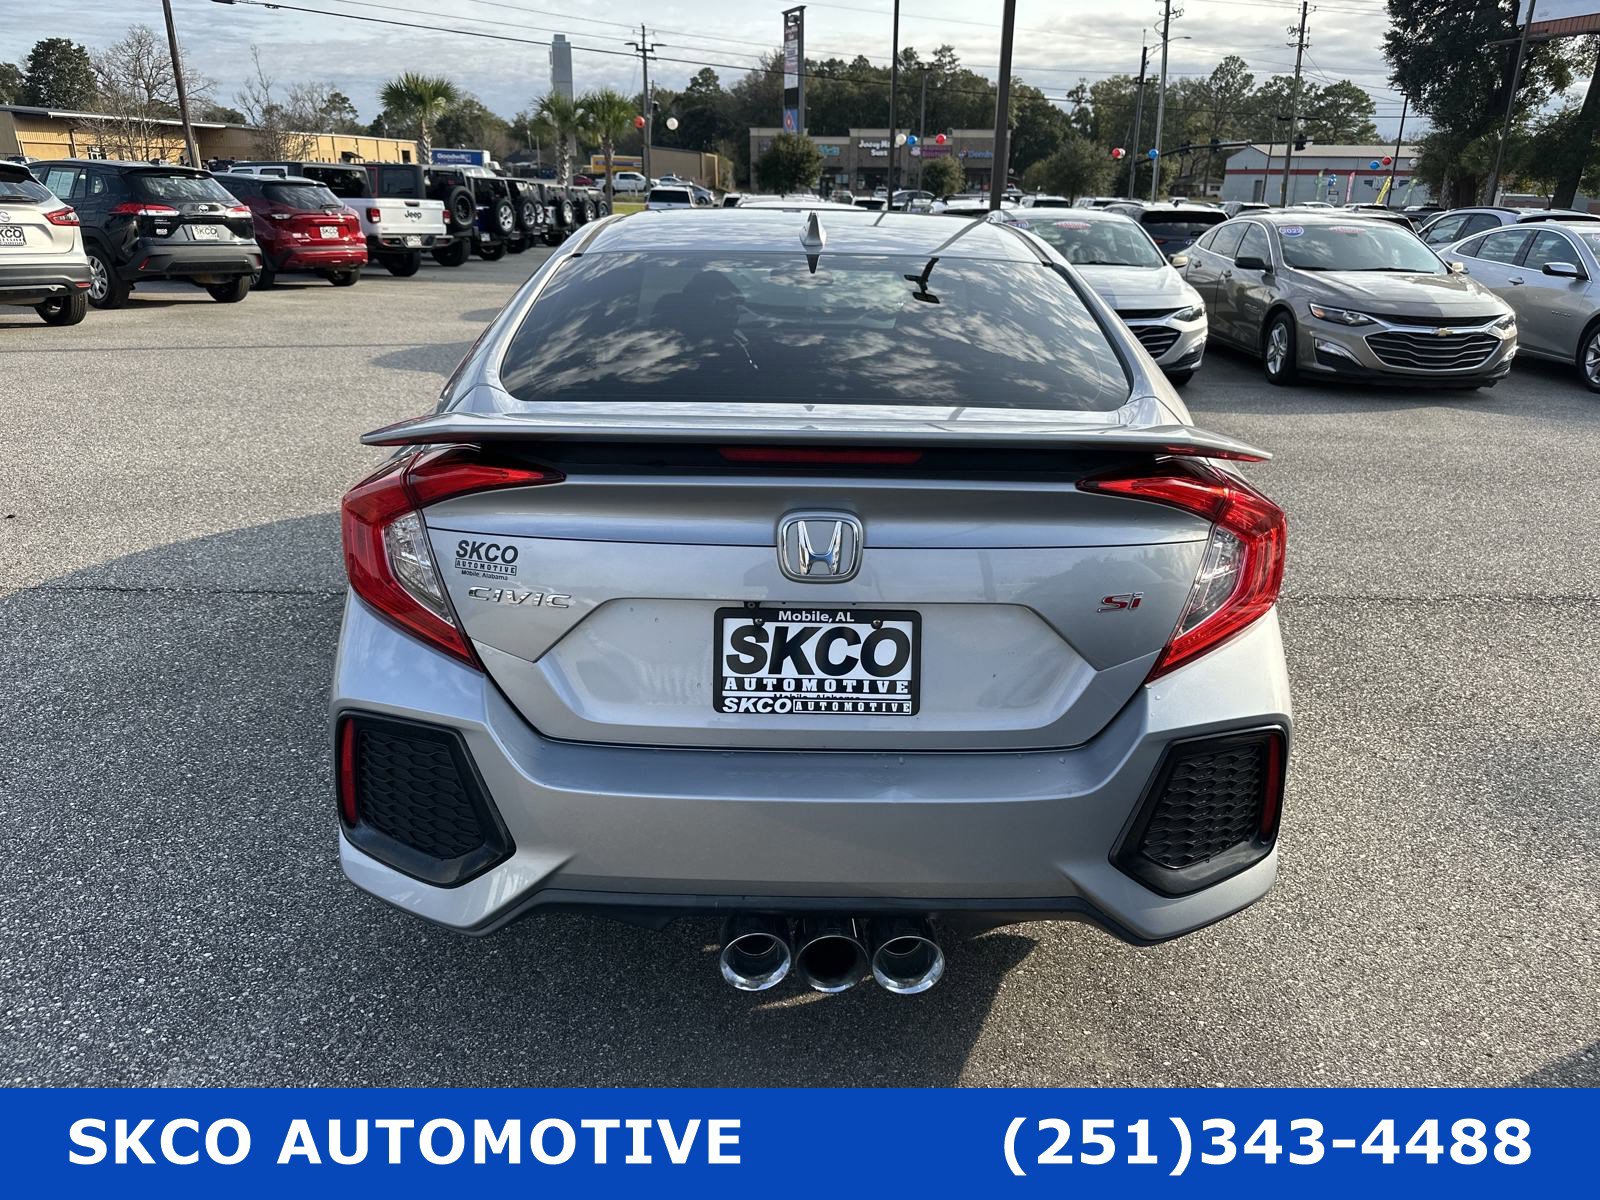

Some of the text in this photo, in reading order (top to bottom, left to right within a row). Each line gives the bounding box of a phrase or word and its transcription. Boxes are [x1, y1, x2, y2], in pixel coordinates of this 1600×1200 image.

[404, 210, 422, 219] Jeep
[456, 539, 519, 564] SKCO
[456, 560, 516, 573] AUTOMOTIVE
[461, 569, 508, 581] Mobile, Alabama
[469, 586, 572, 608] CIVIC
[1097, 592, 1144, 613] Si
[778, 611, 855, 622] Mobile, AL
[726, 624, 911, 678] SKCO
[724, 677, 909, 694] AUTOMOTIVE
[723, 698, 911, 713] SKCO AUTOMOTIVE
